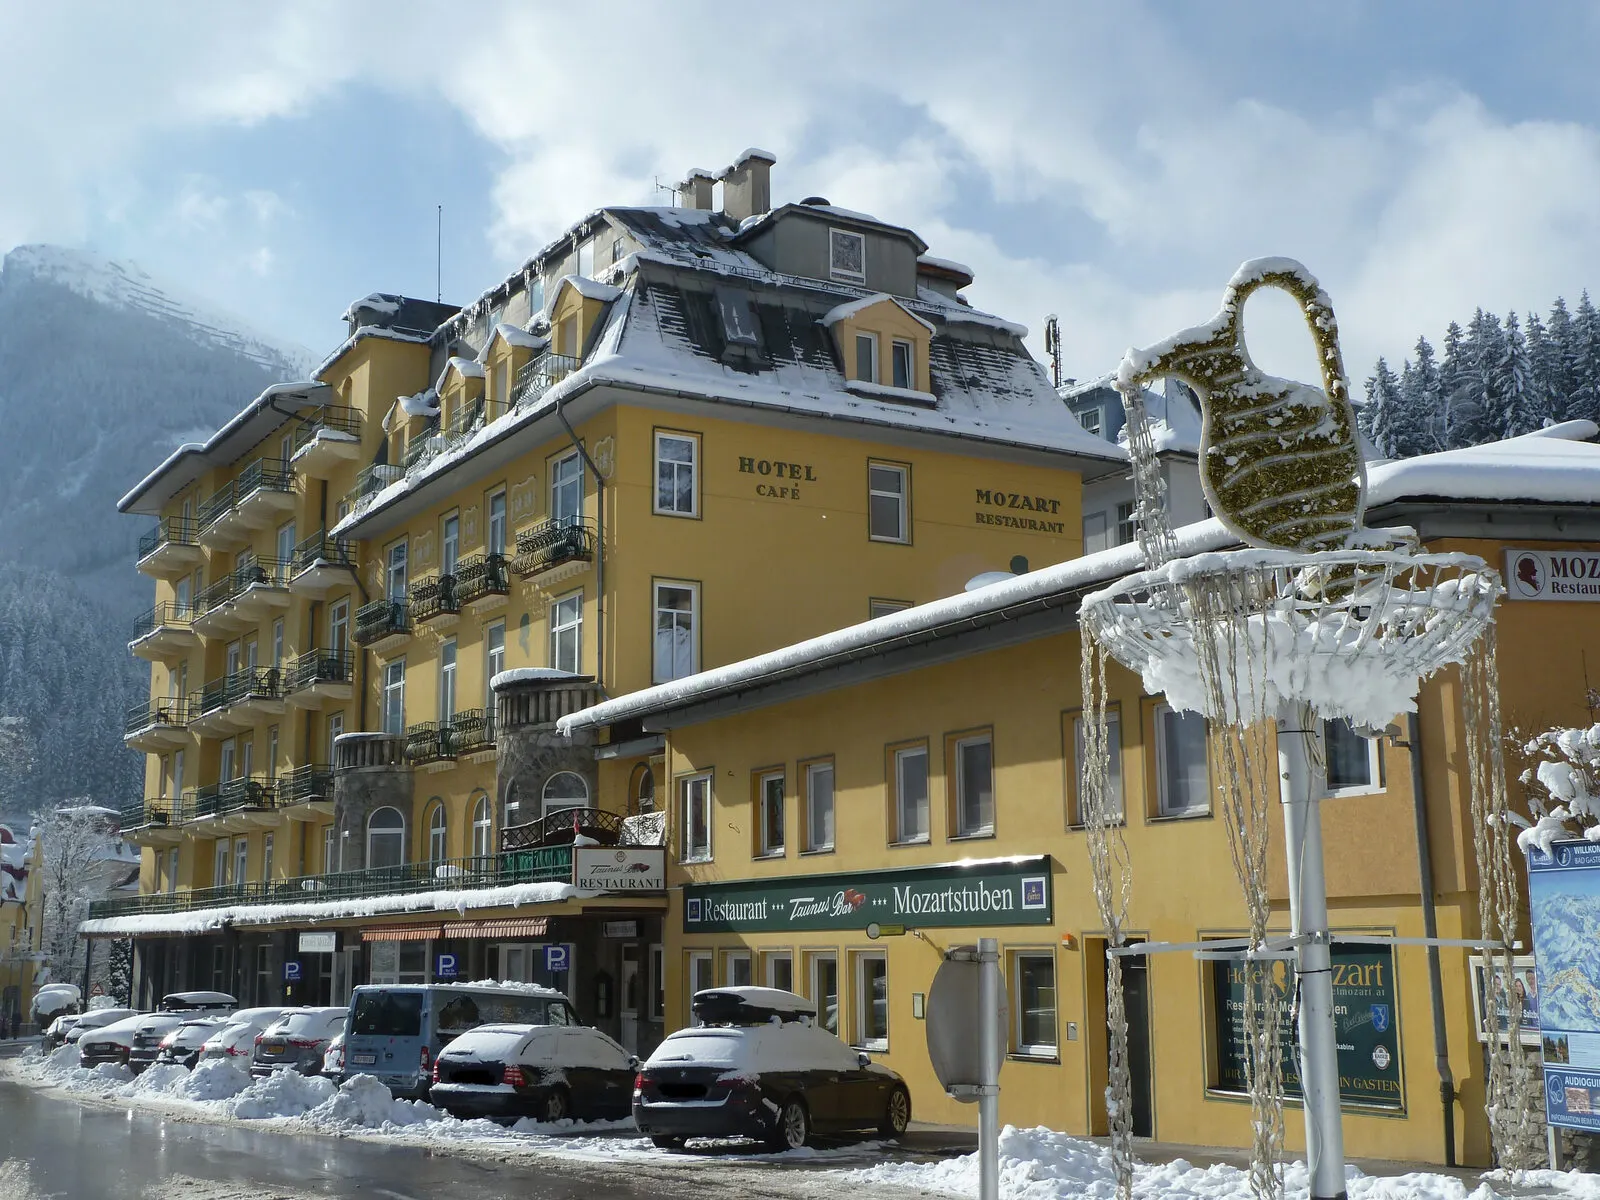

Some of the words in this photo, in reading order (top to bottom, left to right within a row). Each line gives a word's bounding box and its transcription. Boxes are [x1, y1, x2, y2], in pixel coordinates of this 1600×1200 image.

[738, 456, 817, 482] HOTEL
[756, 482, 800, 500] CAFÉ
[976, 489, 1061, 515] MOZART
[975, 512, 1064, 534] RESTAURANT
[580, 878, 662, 889] RESTAURANT
[704, 897, 768, 922] Restaurant
[789, 896, 830, 921] Taunus
[830, 890, 853, 917] Bar
[892, 880, 1014, 914] Mozartstuben
[438, 954, 455, 976] P
[547, 946, 566, 971] P
[285, 962, 299, 980] P
[1353, 1077, 1400, 1091] GASTEIN
[1551, 1113, 1580, 1125] INFORMATION
